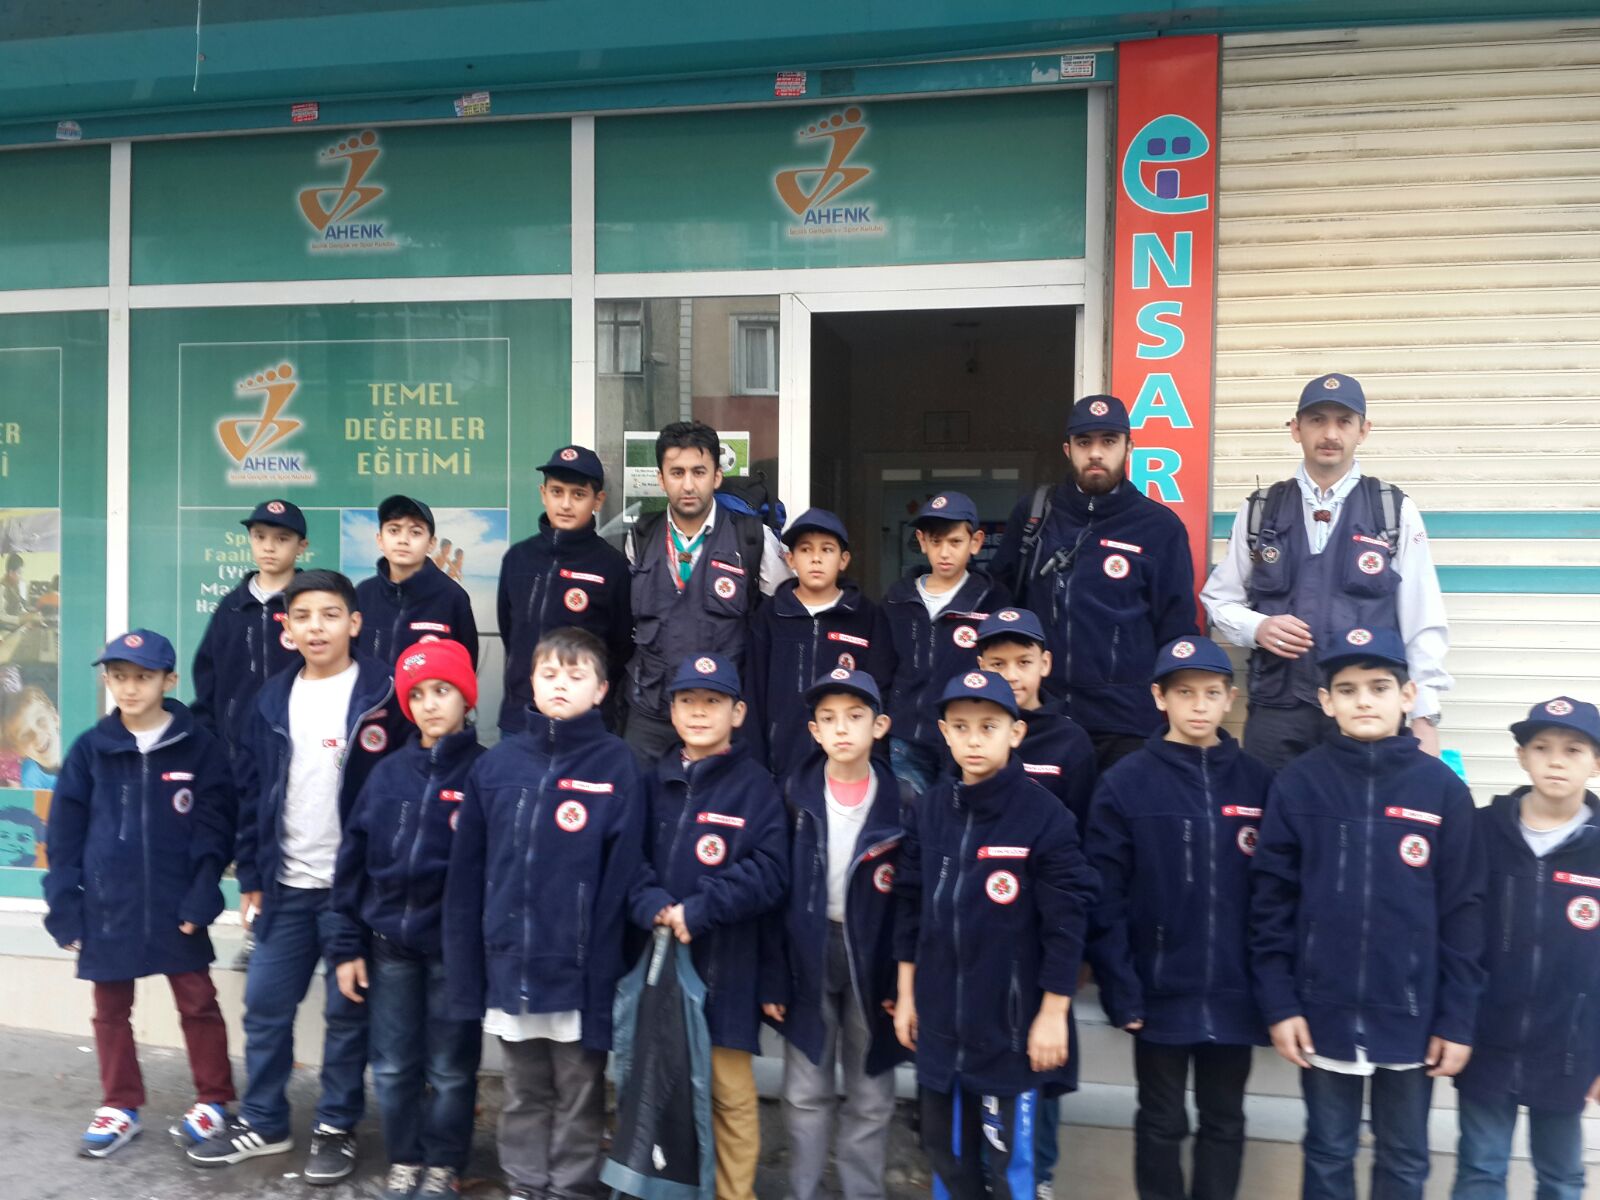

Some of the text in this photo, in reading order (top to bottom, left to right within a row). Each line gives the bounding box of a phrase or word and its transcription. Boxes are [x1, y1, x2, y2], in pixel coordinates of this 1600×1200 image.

[804, 206, 871, 225] AHENK
[325, 223, 385, 240] AHENK
[367, 382, 459, 406] TEMEL
[344, 410, 485, 441] DEĞERLER
[243, 456, 302, 471] AHENK
[357, 445, 471, 475] EĞİTİMİ
